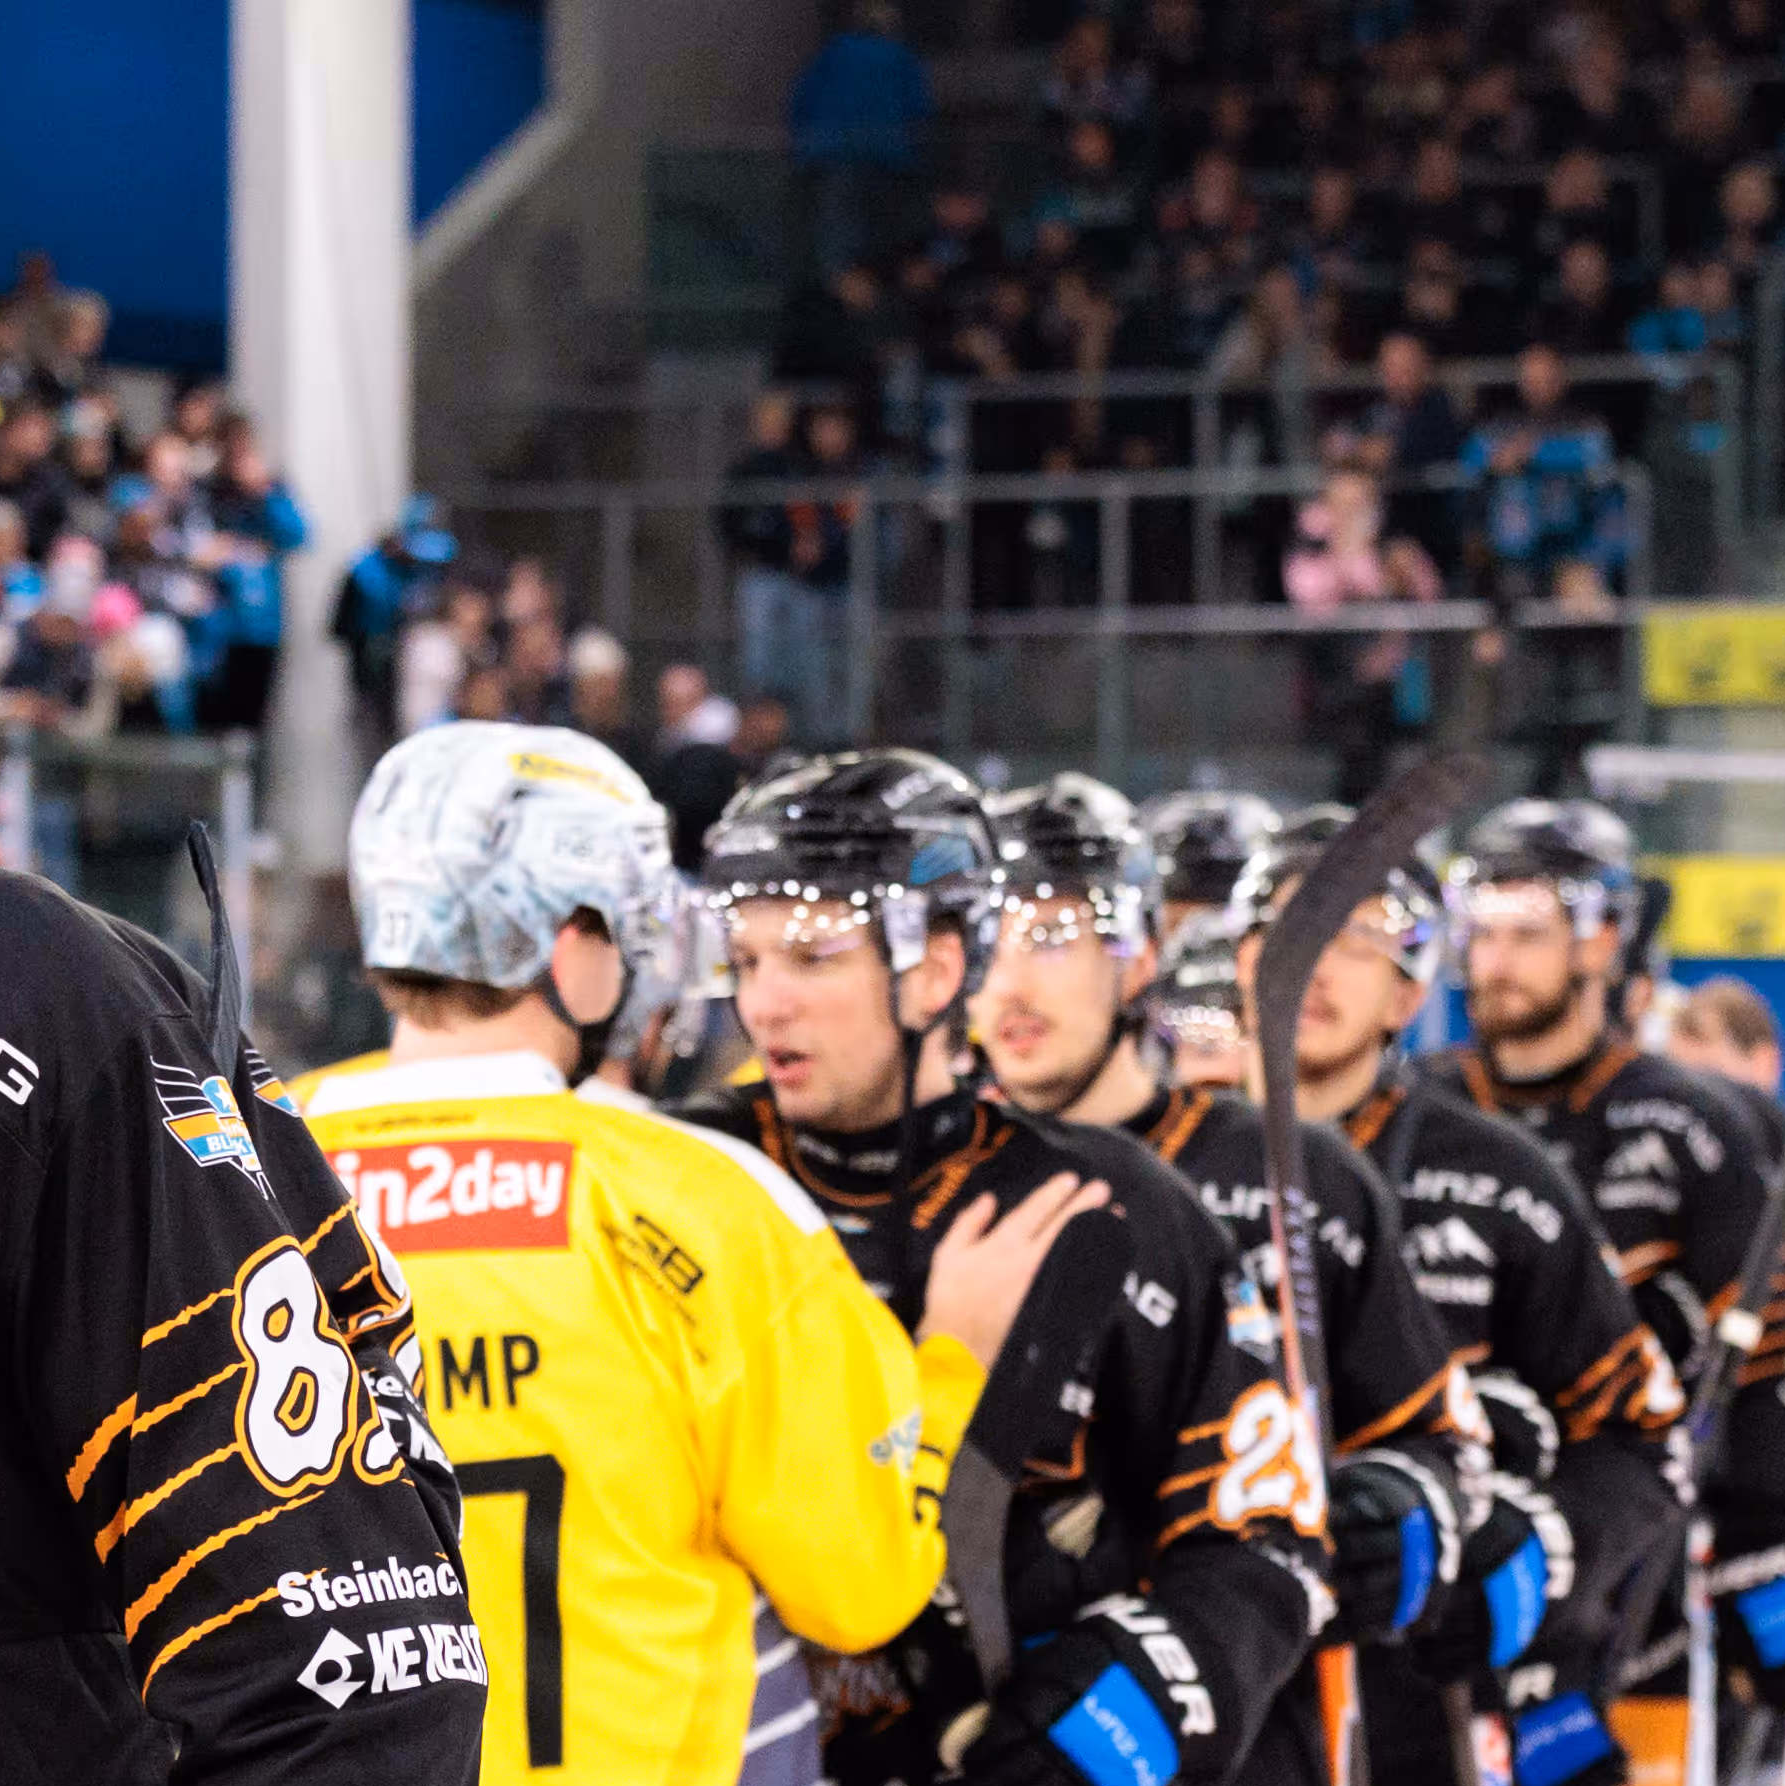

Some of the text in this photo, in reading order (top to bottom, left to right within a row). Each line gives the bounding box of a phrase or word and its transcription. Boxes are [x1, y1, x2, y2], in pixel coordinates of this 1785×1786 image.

[236, 1240, 406, 1493] 8
[421, 1334, 540, 1413] MP
[366, 1627, 422, 1694] KE
